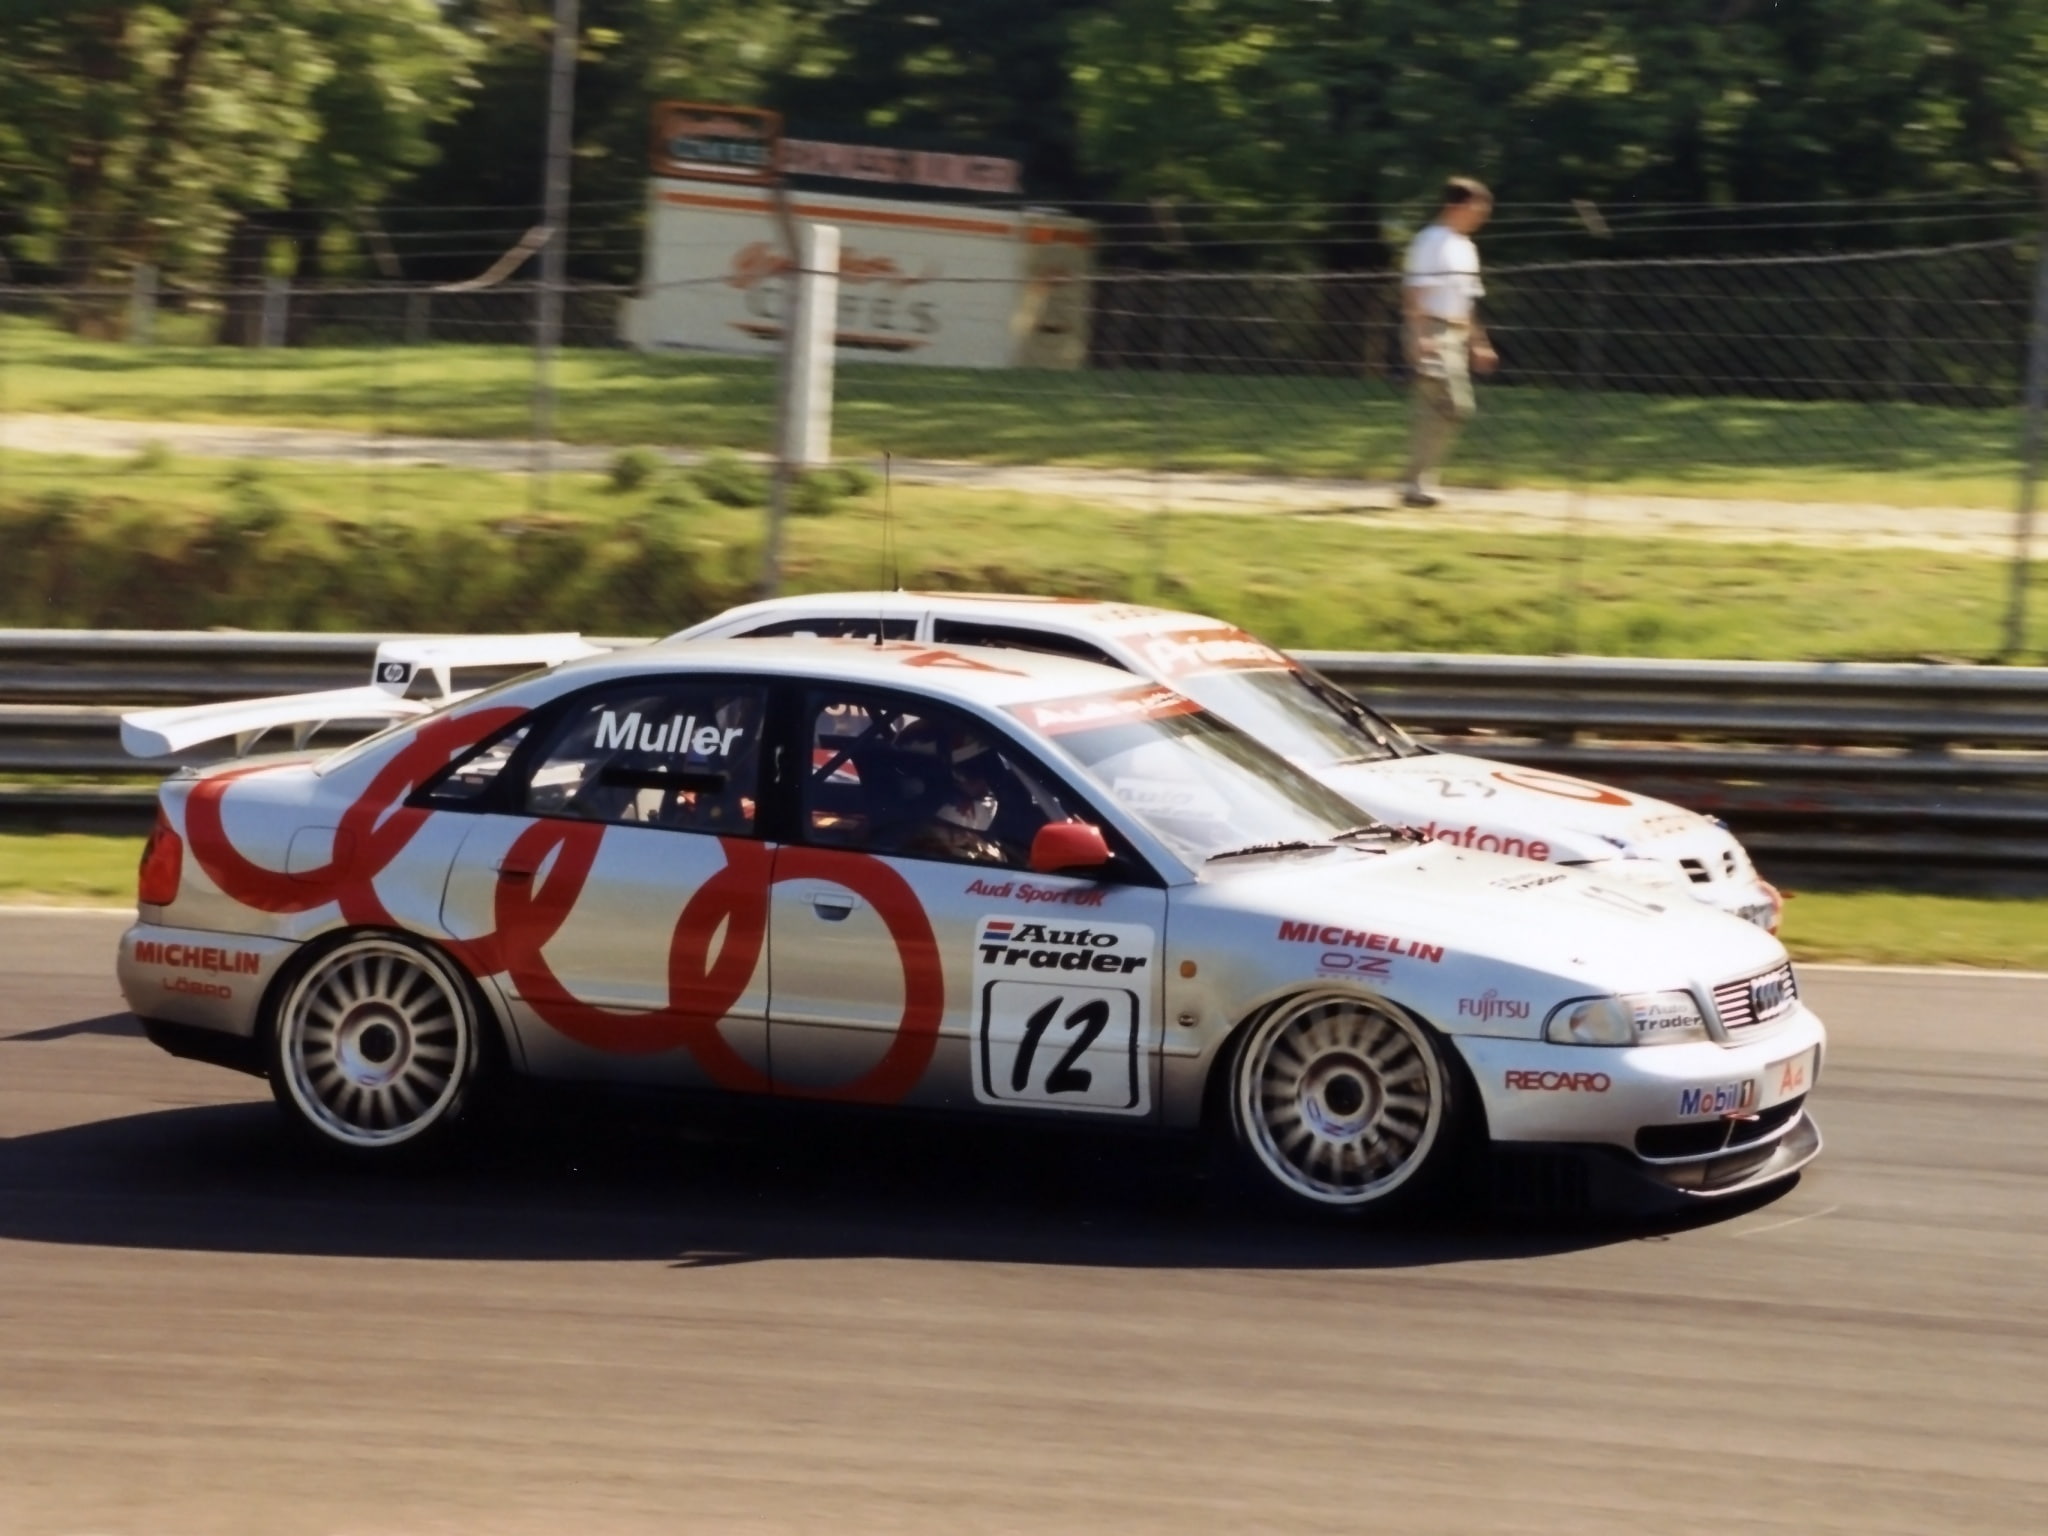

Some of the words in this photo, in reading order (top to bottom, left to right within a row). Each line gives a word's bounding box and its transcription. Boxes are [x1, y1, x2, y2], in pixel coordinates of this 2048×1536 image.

[595, 711, 743, 756] Muller
[1397, 821, 1550, 862] dafone
[965, 879, 1013, 898] Audi
[1015, 884, 1071, 905] Sport
[1010, 923, 1119, 948] Auto
[1277, 920, 1445, 963] MICHELIN
[134, 940, 262, 975] MICHELIN
[978, 943, 1148, 974] Trader
[1458, 989, 1530, 1022] FUJITSU
[1635, 1015, 1702, 1032] Trader
[1011, 996, 1110, 1095] 12
[1505, 1070, 1611, 1092] RECARO
[1679, 1083, 1739, 1116] Mobil
